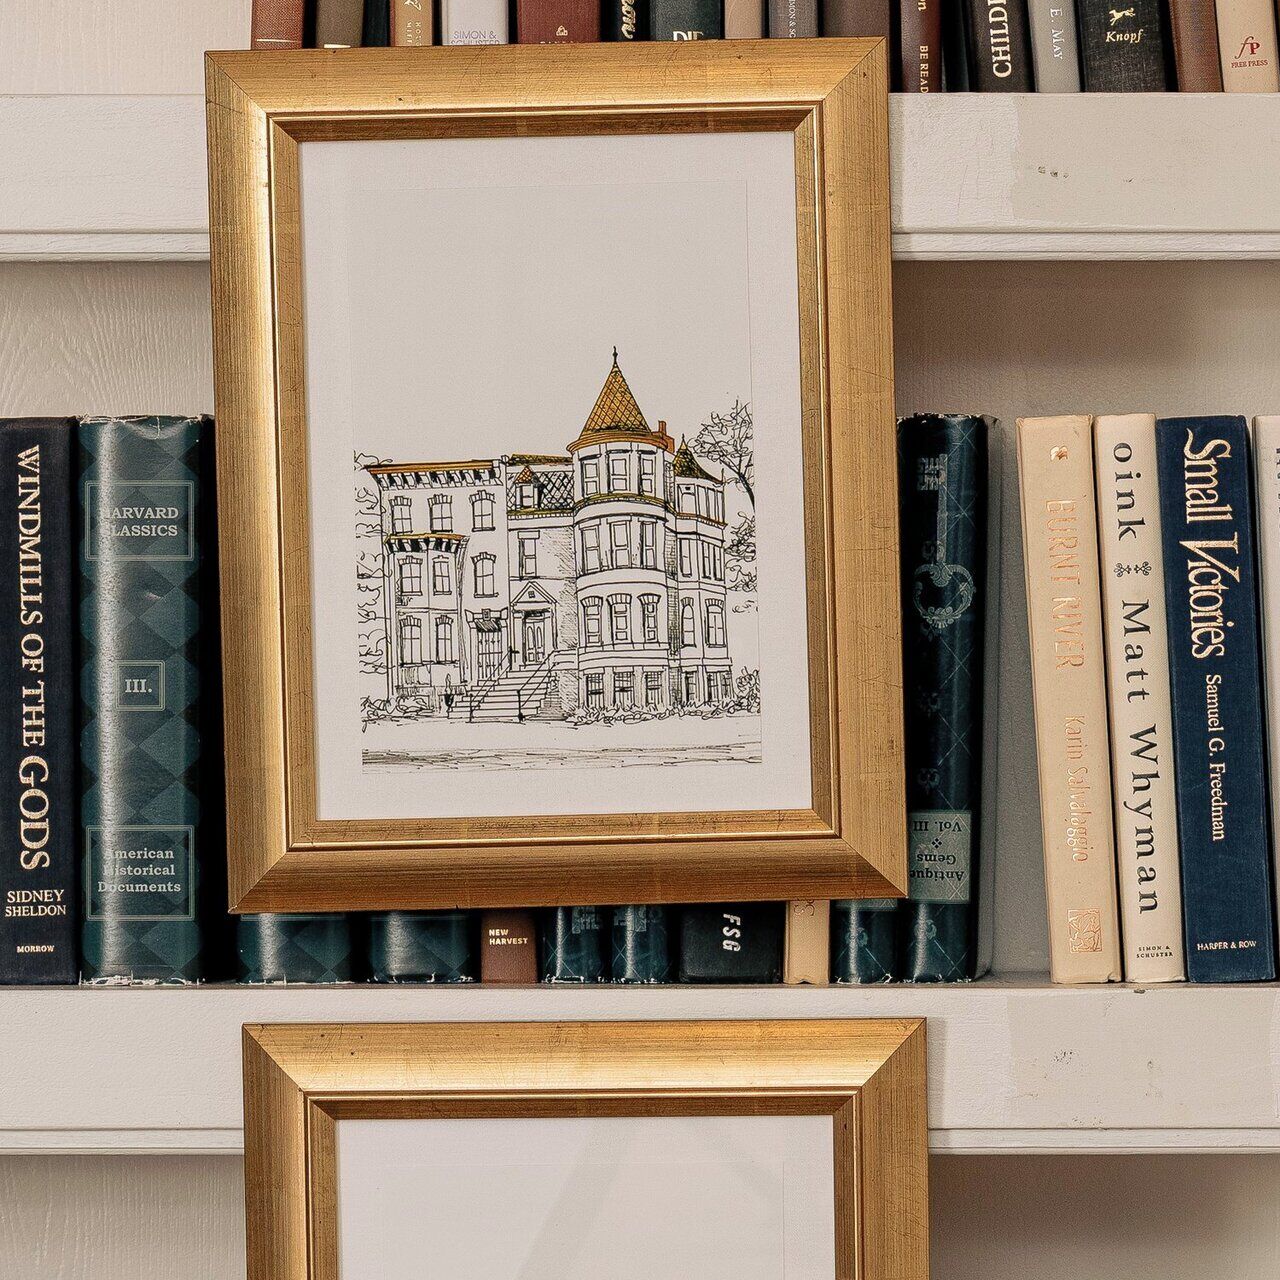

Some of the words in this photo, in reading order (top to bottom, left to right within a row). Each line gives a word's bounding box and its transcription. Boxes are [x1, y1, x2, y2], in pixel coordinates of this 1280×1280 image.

[1114, 442, 1138, 541] oink
[1184, 428, 1230, 525] Small
[16, 445, 43, 625] WINDMILLS
[1179, 532, 1240, 660] Victories
[21, 637, 44, 671] OF
[1120, 599, 1150, 702] Matt
[22, 681, 45, 746] THE
[1205, 674, 1223, 734] Samuel
[1208, 738, 1224, 756] G.
[19, 757, 50, 870] GODS
[1125, 724, 1158, 914] Whyman
[1208, 762, 1225, 841] Freedman
[5, 903, 66, 917] SHELDON
[8, 889, 64, 902] SIDNEY
[722, 913, 742, 952] FSG
